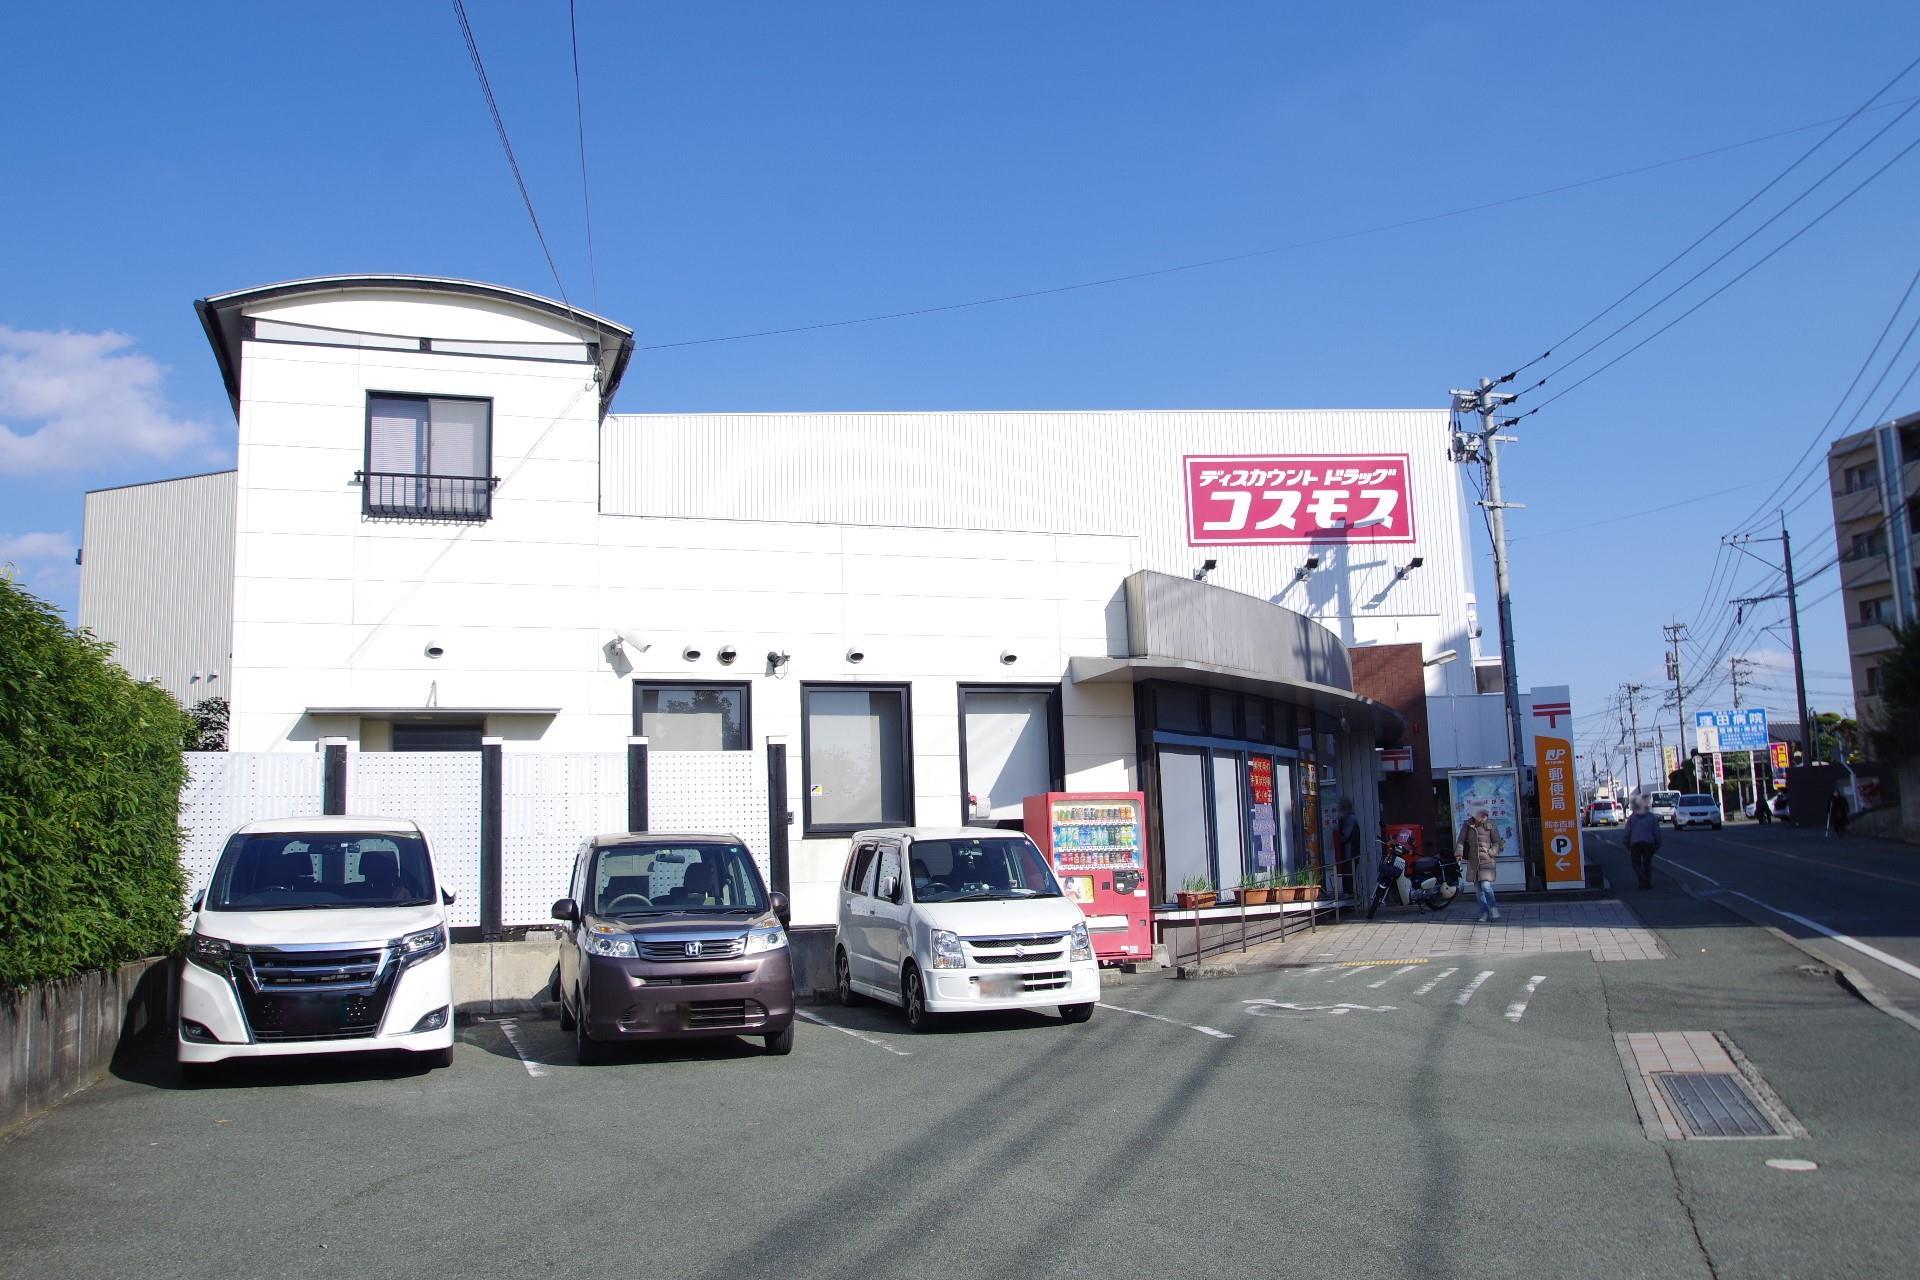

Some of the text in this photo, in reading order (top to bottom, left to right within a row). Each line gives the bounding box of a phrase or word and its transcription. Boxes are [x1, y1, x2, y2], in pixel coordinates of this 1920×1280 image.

[1200, 468, 1397, 487] ディスカウント ドラッグ
[1202, 489, 1399, 531] コスモス
[1548, 767, 1566, 811] 郵便局
[1556, 838, 1568, 854] P
